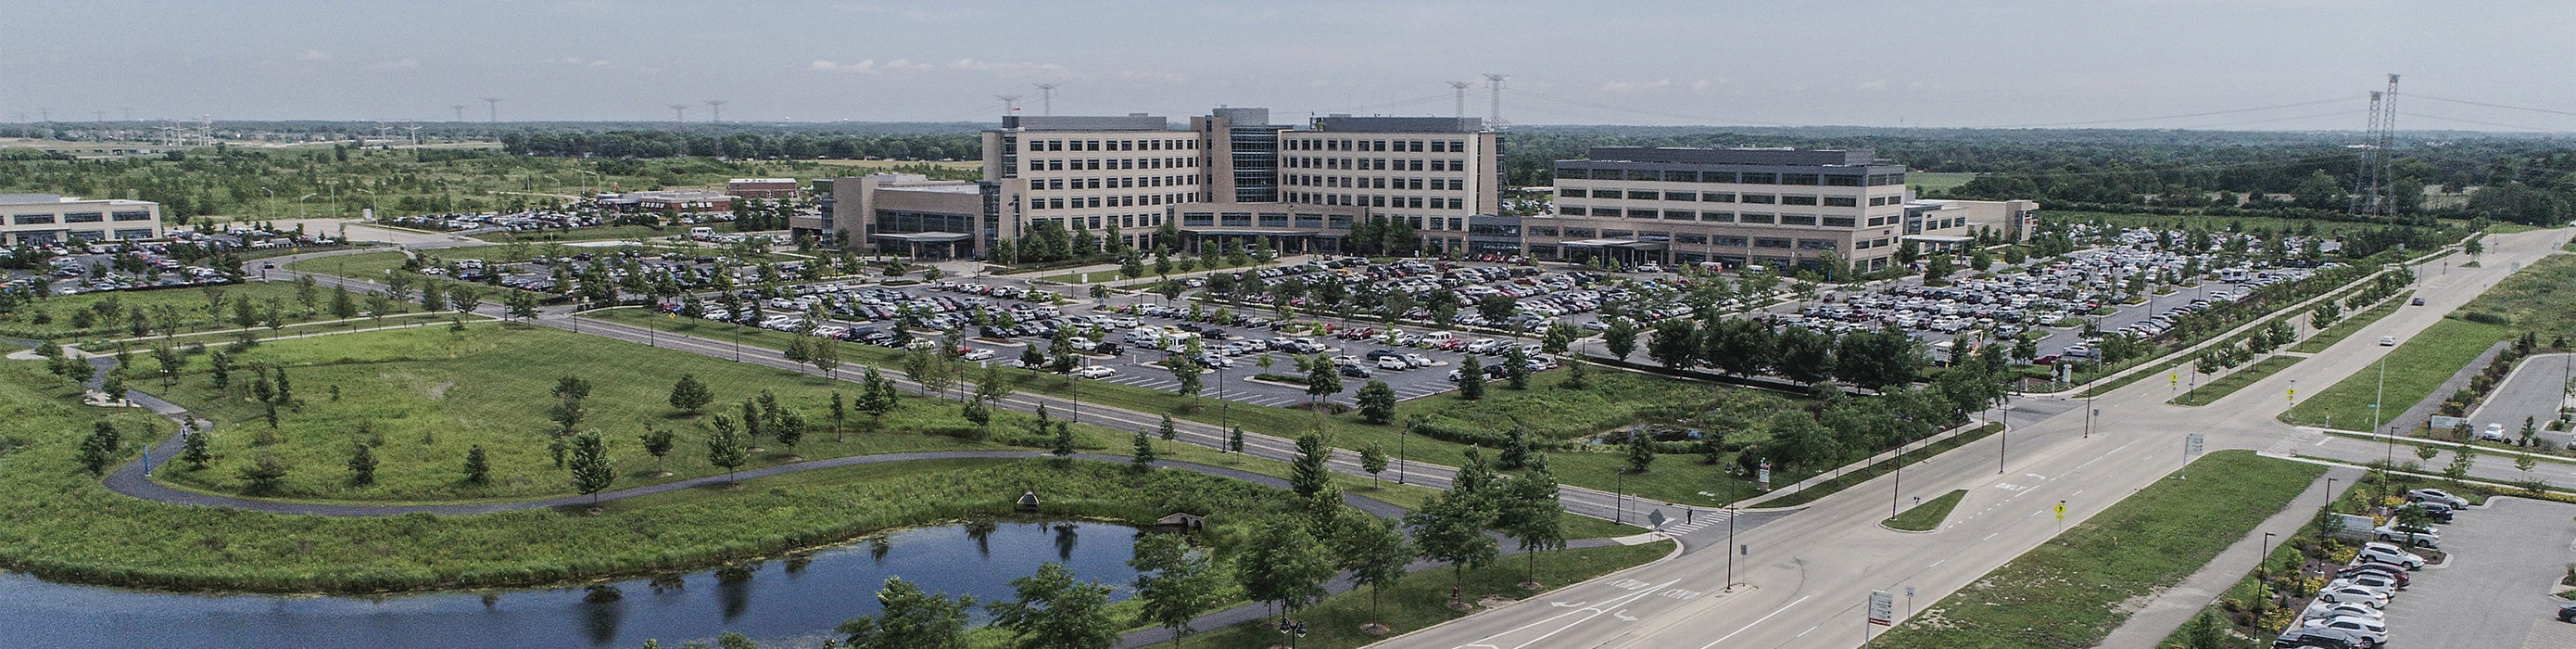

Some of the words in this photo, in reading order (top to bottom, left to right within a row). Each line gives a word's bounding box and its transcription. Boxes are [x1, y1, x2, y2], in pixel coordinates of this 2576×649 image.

[1994, 482, 2027, 491] ONLY
[1606, 578, 1650, 591] ONLY
[1657, 588, 1701, 601] ONLY
